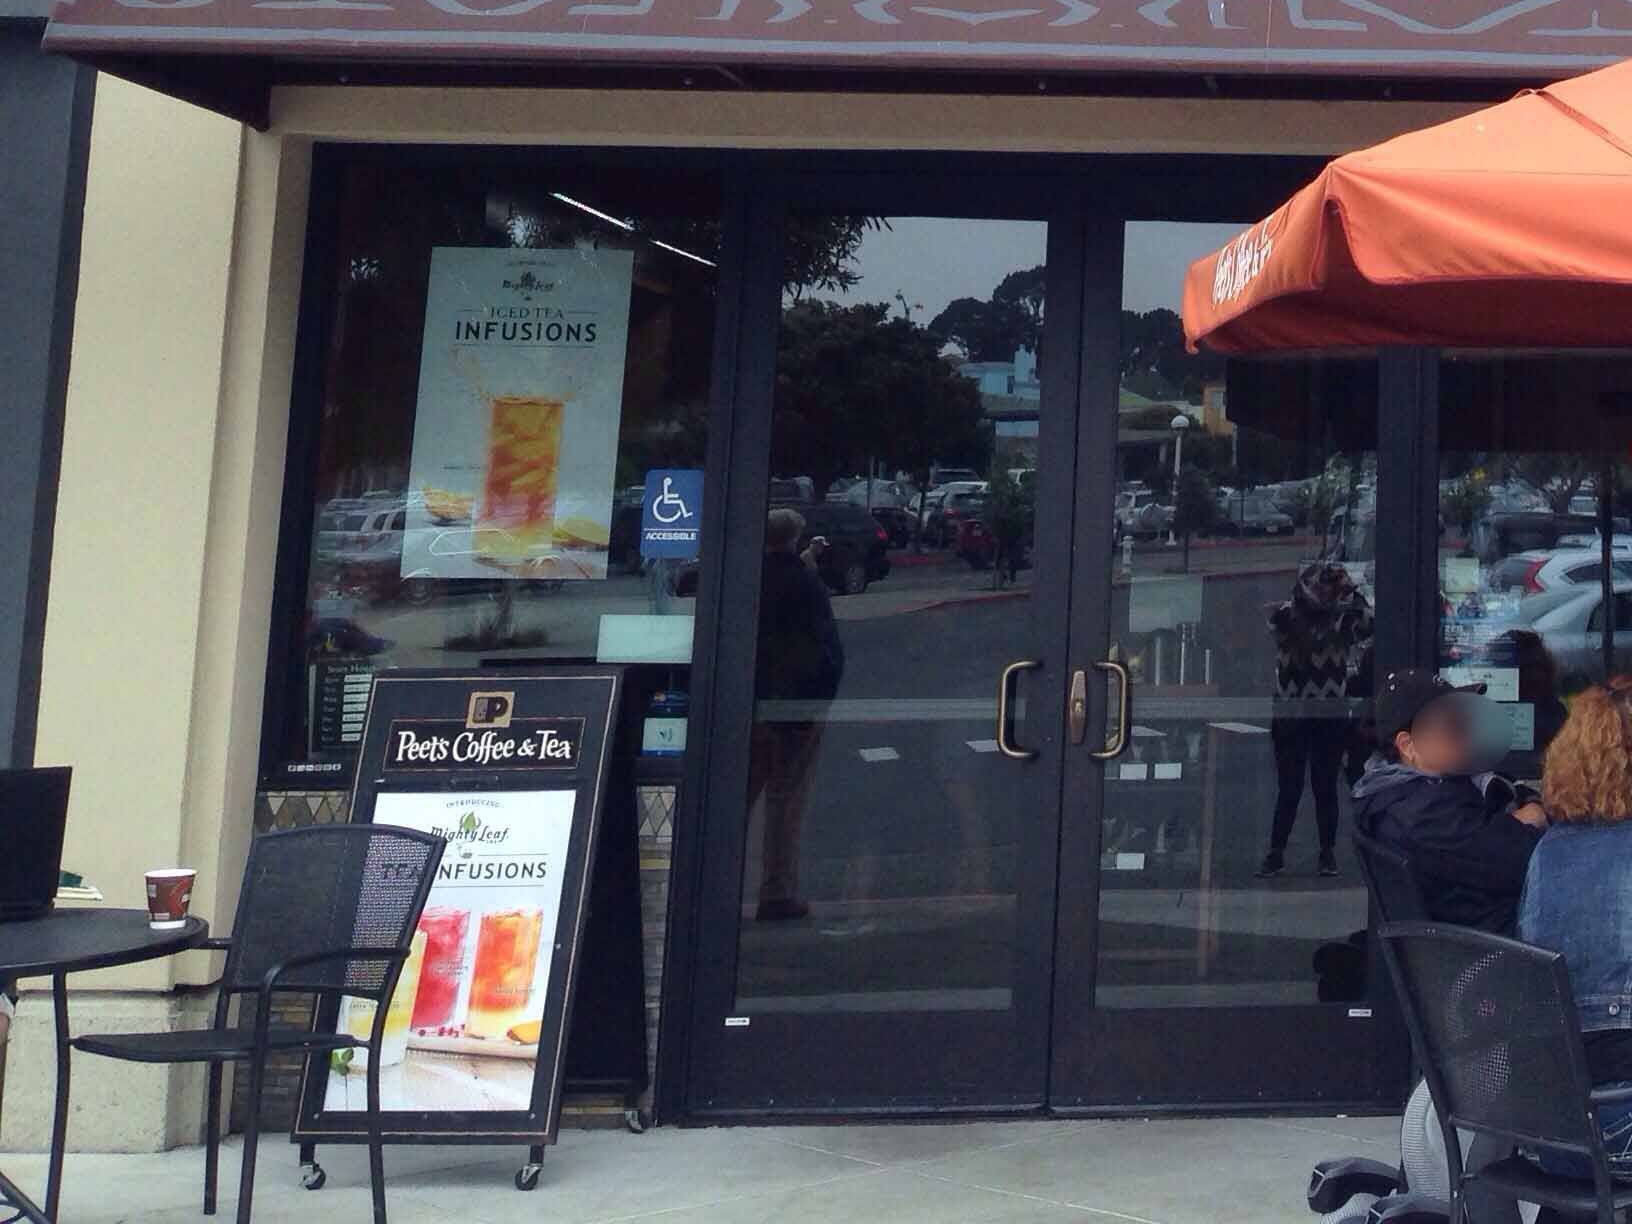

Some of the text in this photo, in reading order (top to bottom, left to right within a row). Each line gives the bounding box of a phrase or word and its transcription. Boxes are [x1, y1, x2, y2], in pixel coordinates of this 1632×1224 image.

[490, 307, 564, 320] ICED TEA
[456, 321, 597, 342] INFUSIONS
[645, 531, 697, 541] ACCESSIBLE
[395, 730, 571, 765] Peet's Coffee & Tea
[438, 862, 547, 880] NFUSIONS
